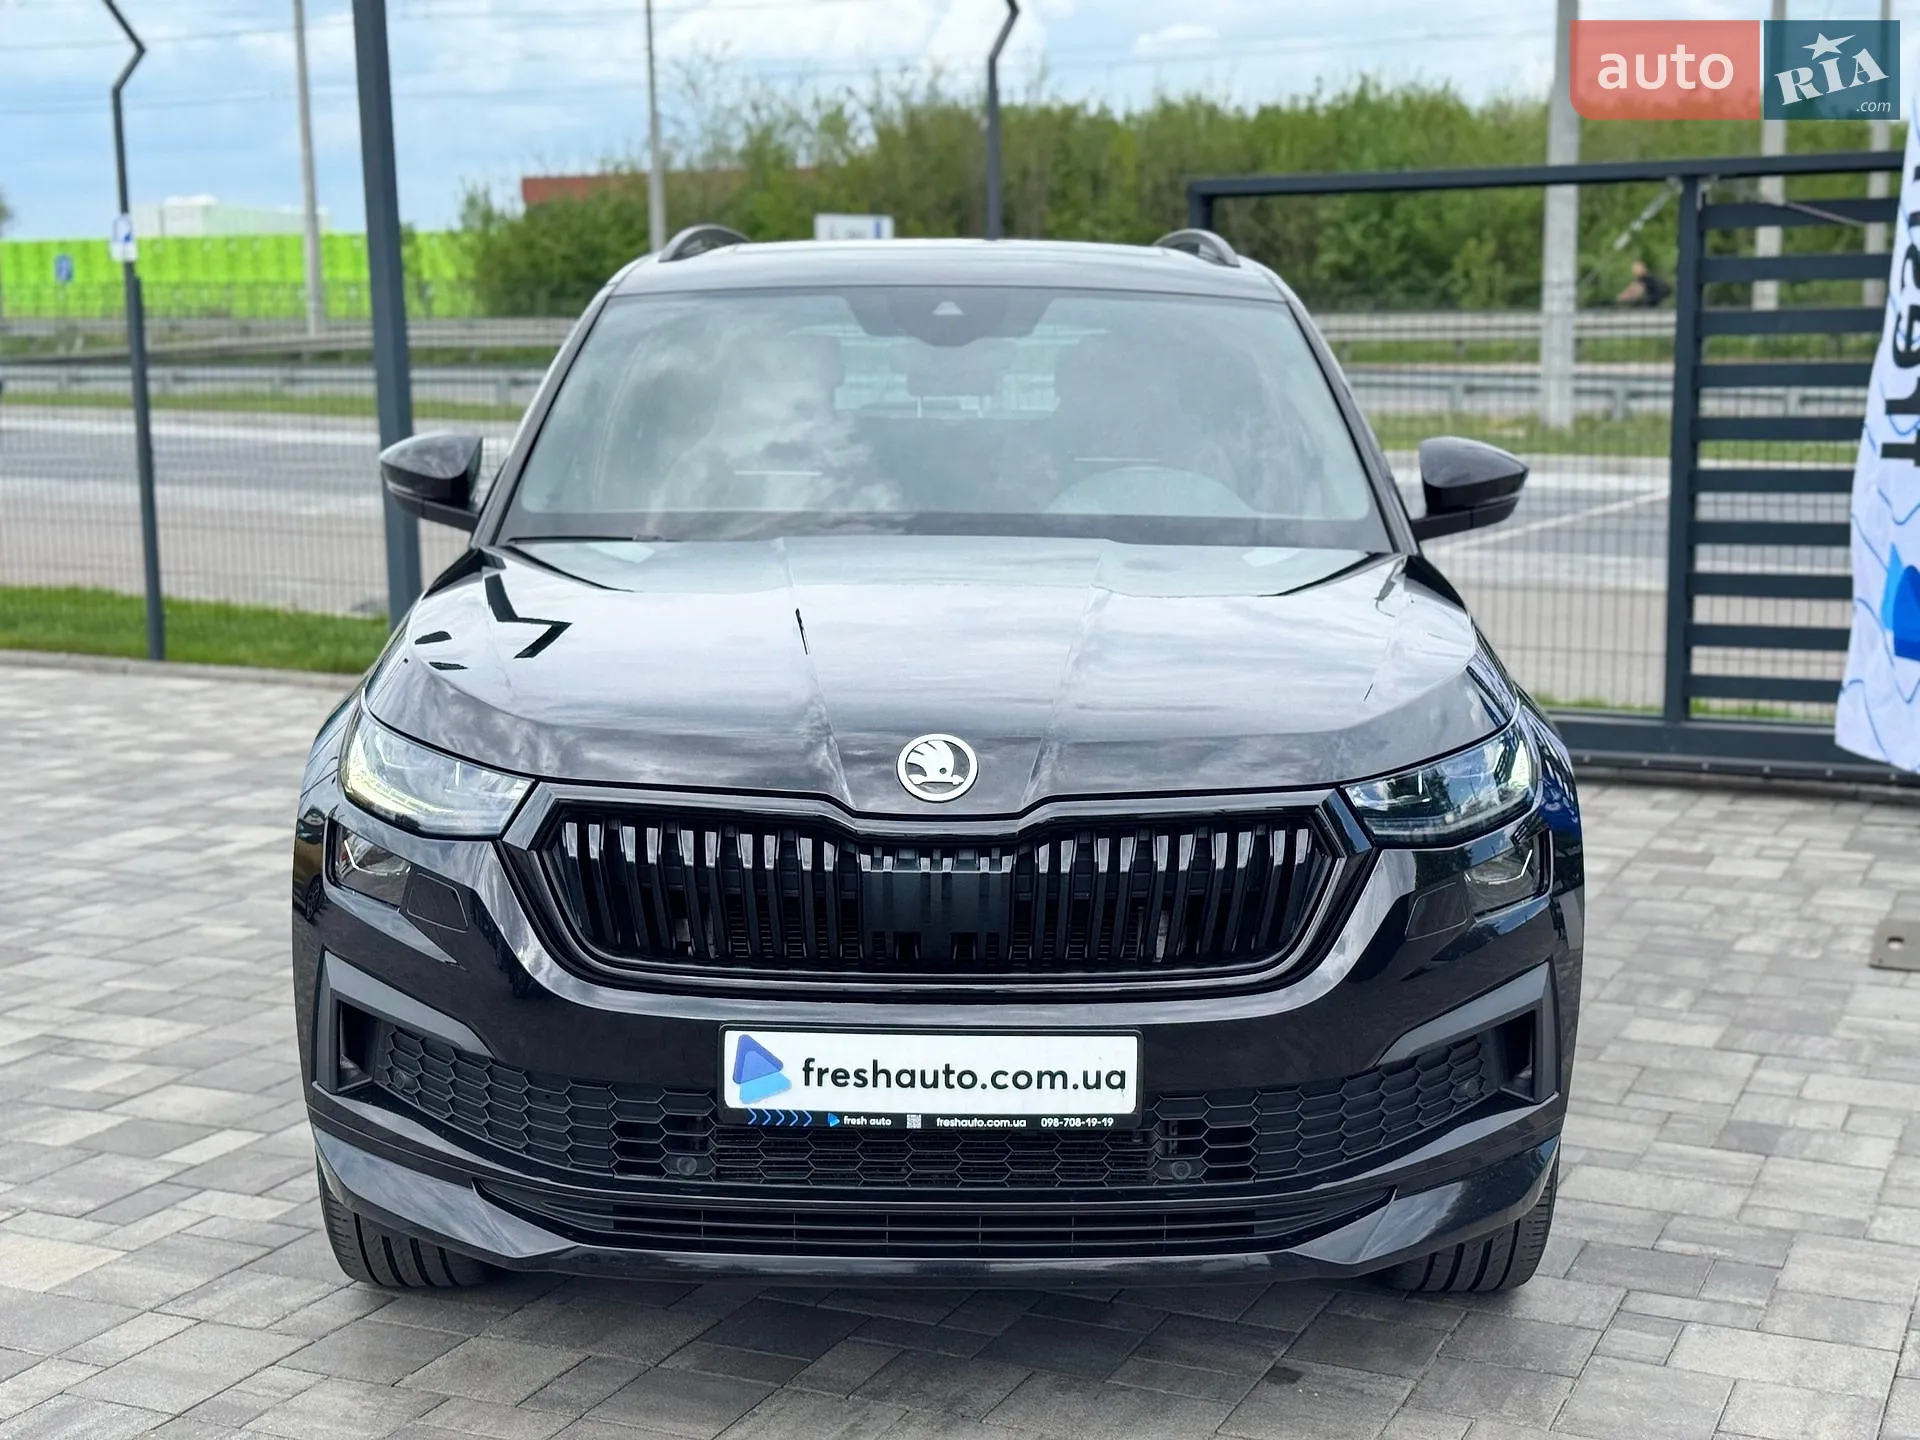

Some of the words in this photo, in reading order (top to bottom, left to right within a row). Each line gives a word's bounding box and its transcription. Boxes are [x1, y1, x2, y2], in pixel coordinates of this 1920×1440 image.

[802, 1058, 1126, 1090] freshauto.com.ua
[843, 1115, 867, 1126] fresh
[869, 1117, 892, 1126] auto
[936, 1117, 1027, 1128] freshauto.com.ua
[1040, 1117, 1115, 1128] 098-708-19-19
